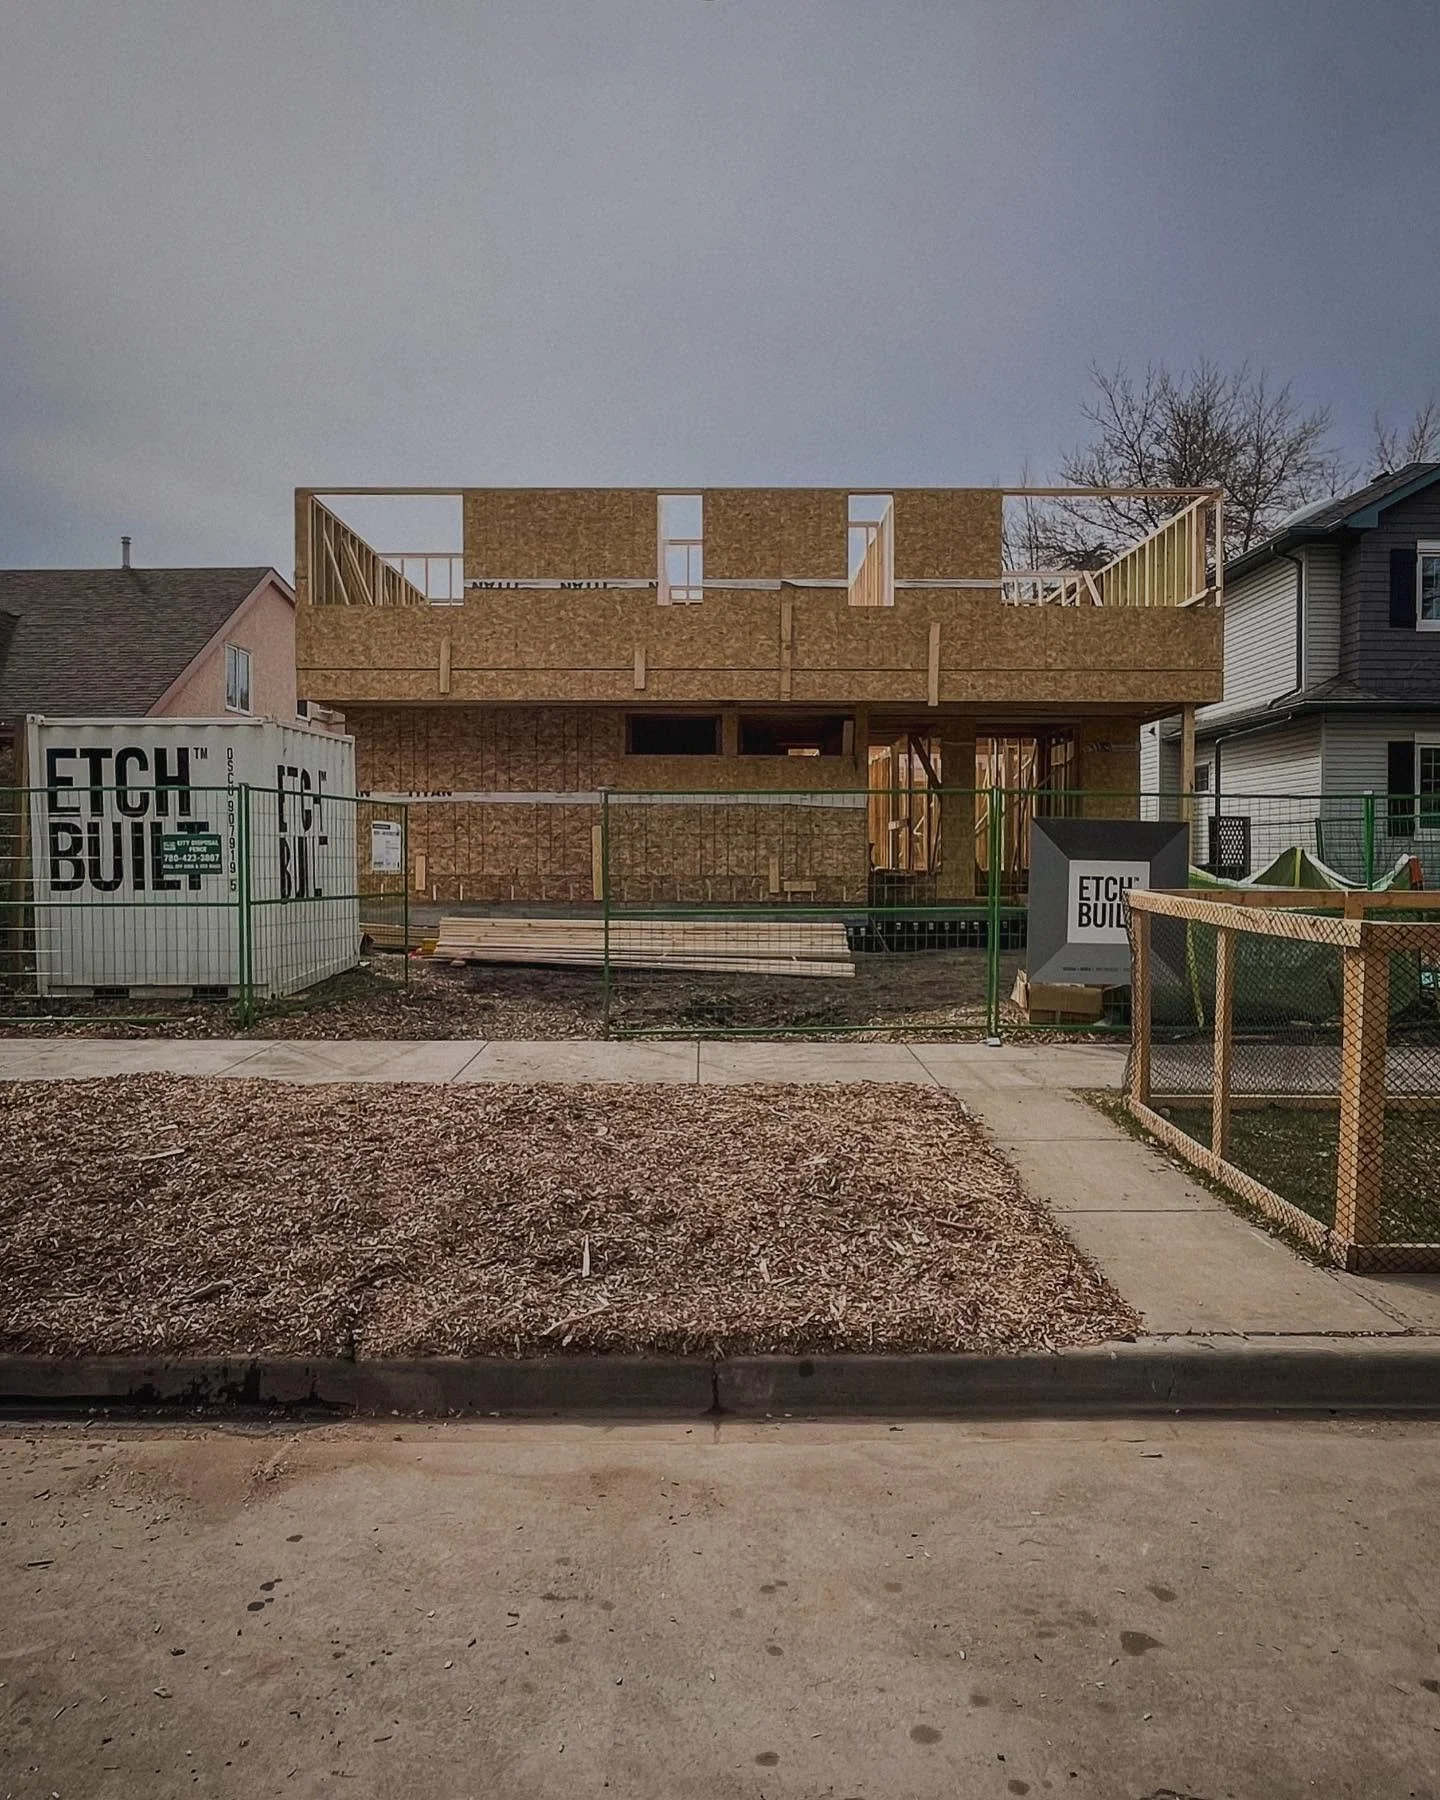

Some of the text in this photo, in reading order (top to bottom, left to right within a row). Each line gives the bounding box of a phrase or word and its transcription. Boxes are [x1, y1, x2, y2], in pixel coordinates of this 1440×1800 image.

[46, 747, 191, 817] ETCH
[49, 821, 209, 891] BUILT
[1078, 876, 1133, 902] ETCH
[1077, 902, 1127, 928] BUIL
